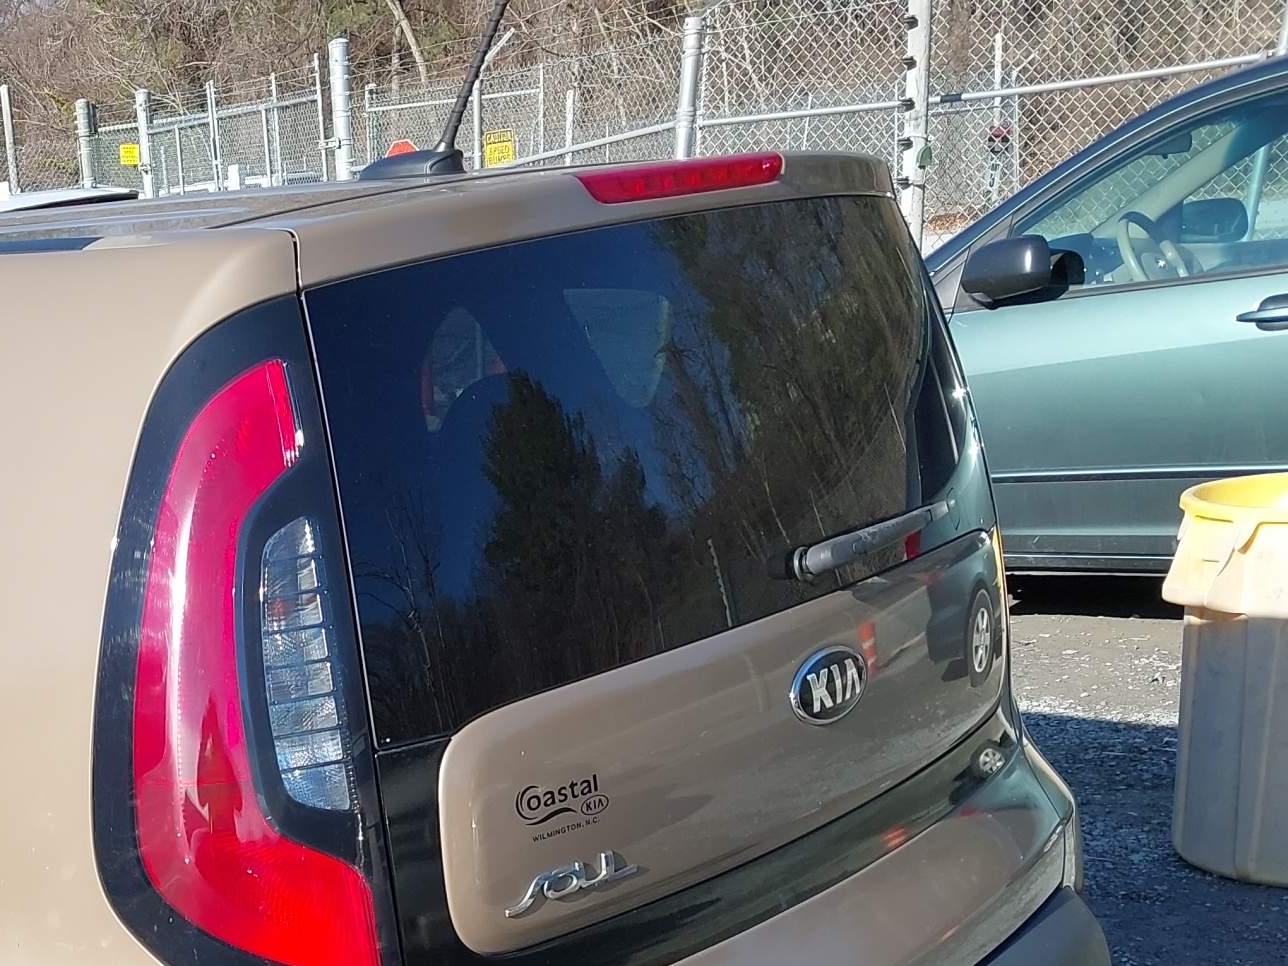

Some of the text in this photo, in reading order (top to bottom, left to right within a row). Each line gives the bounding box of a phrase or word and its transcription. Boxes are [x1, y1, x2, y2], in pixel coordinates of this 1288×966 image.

[806, 658, 861, 713] KIA
[516, 774, 599, 820] Coastal
[585, 799, 604, 812] KIA
[532, 822, 584, 842] WILMINGTON,
[505, 851, 638, 918] SOUL
